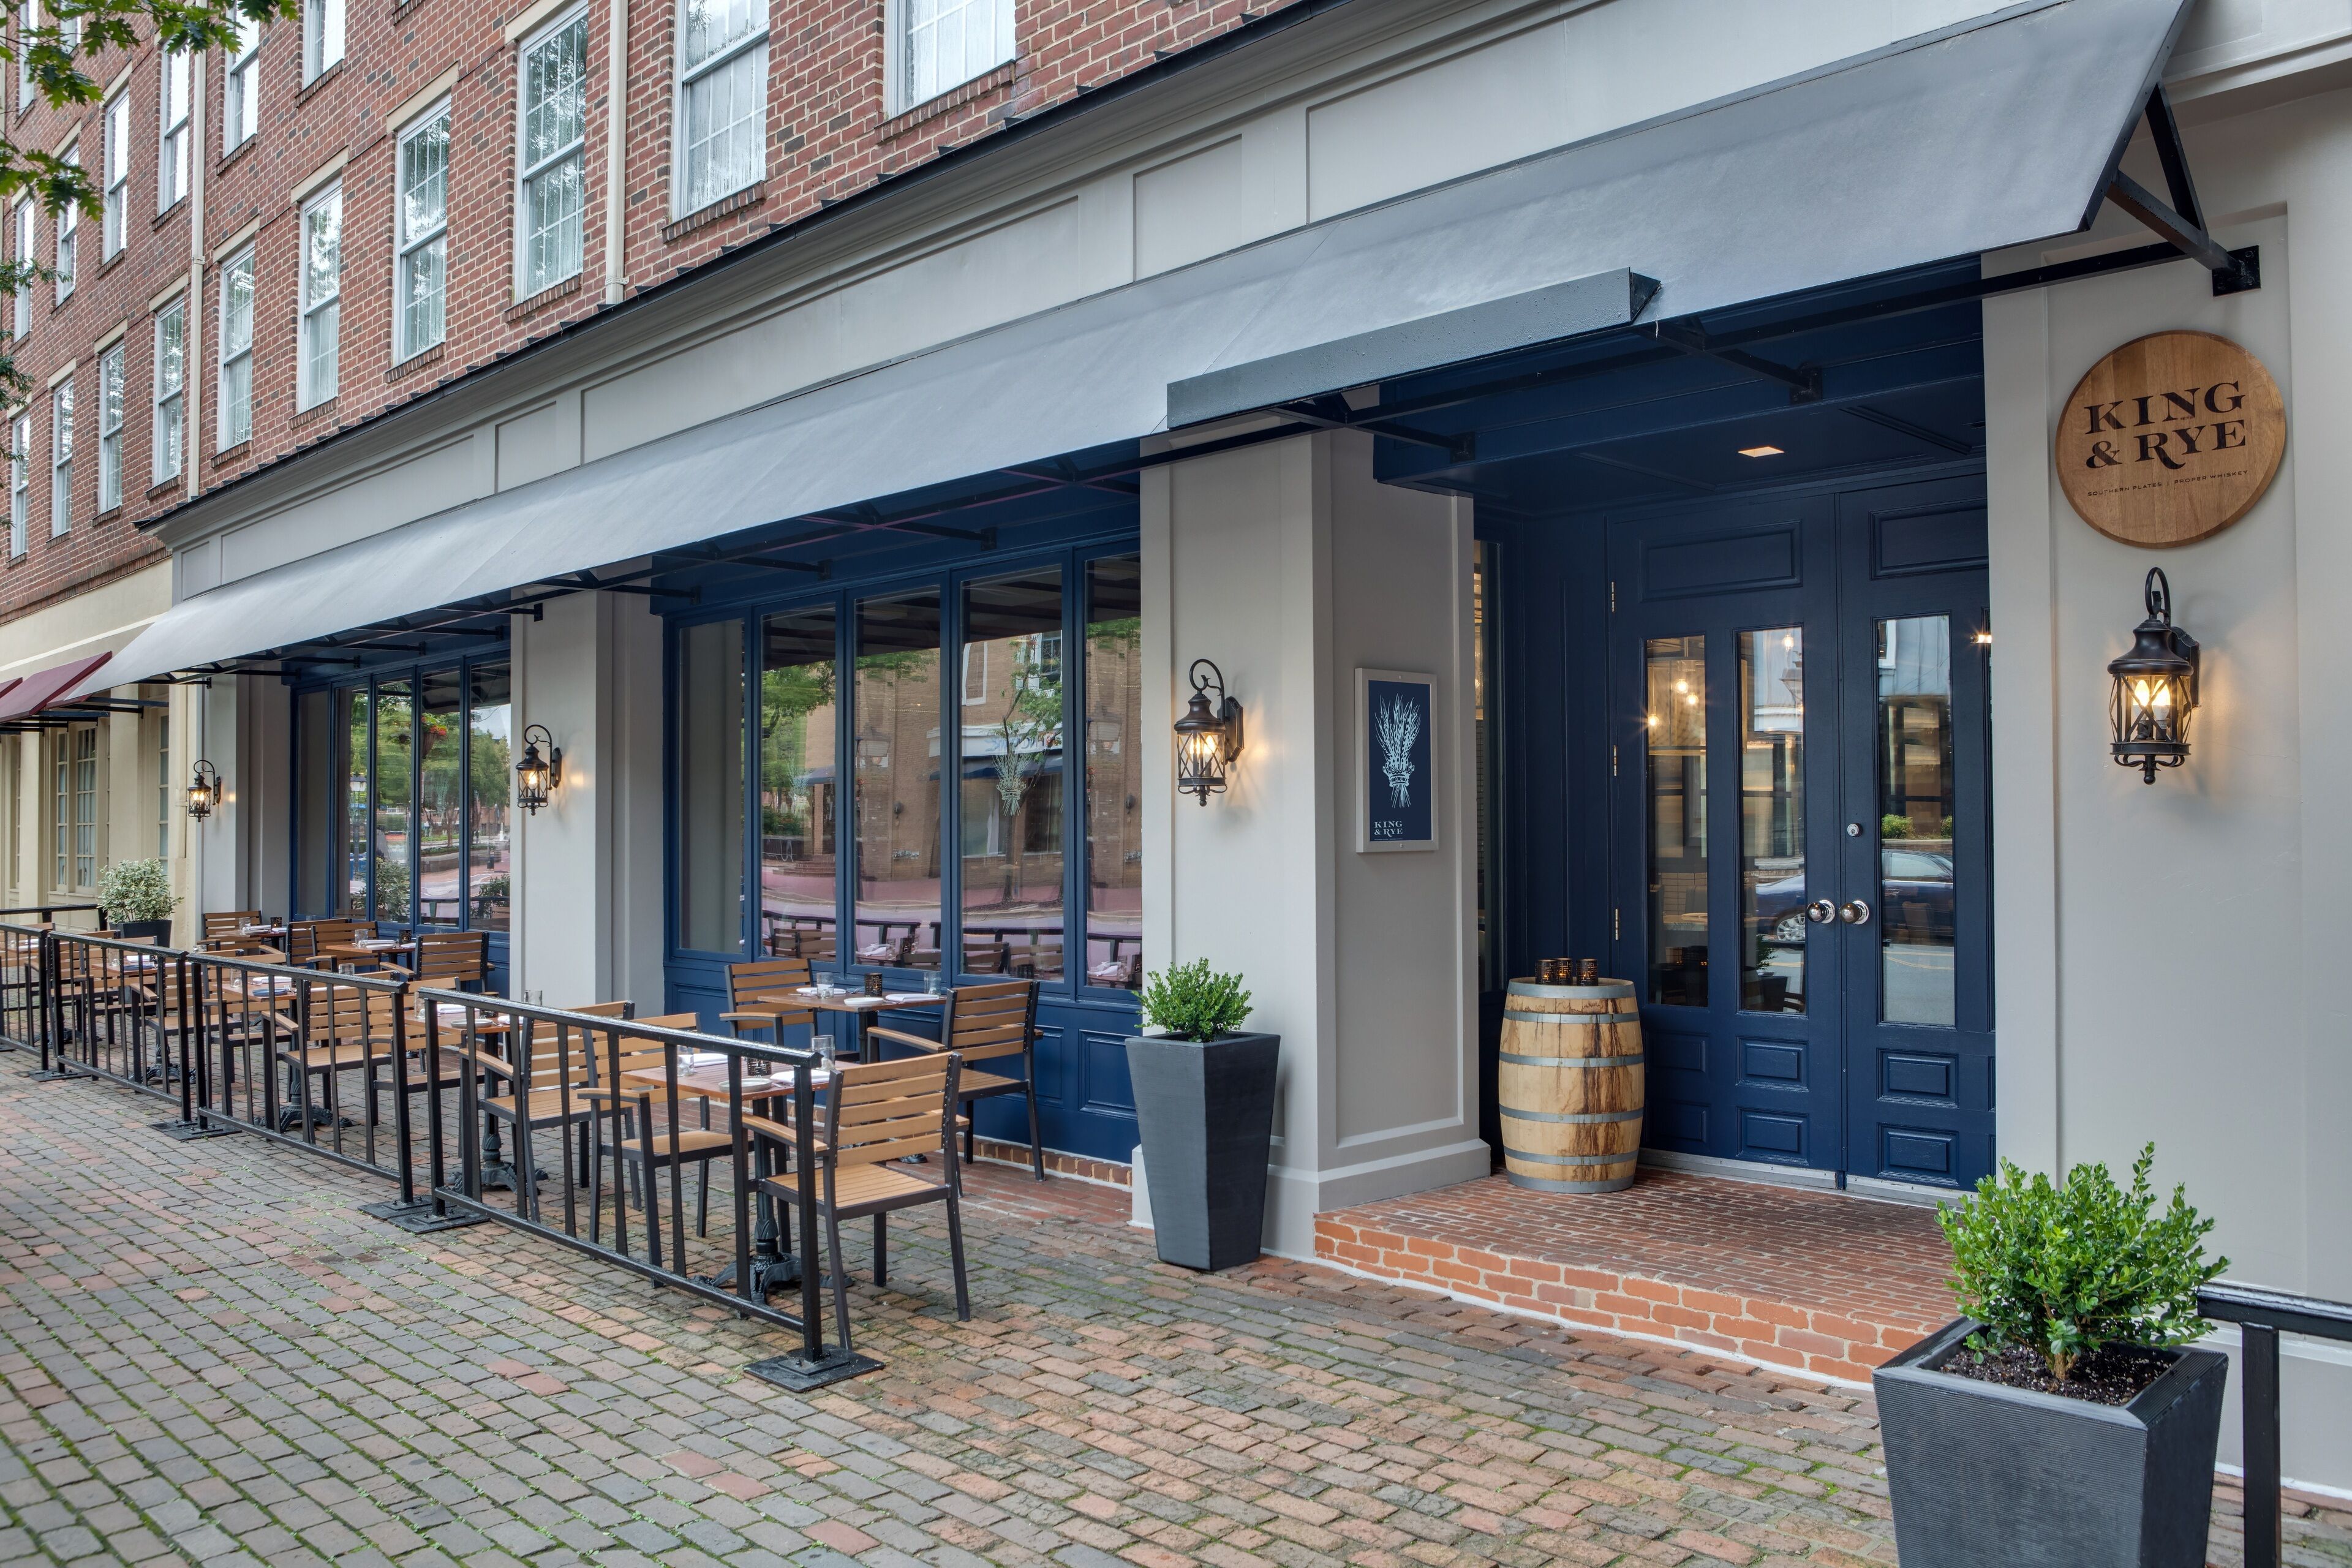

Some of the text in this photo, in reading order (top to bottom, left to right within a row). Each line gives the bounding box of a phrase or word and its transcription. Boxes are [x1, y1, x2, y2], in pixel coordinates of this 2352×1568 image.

[2084, 380, 2246, 435] KING
[2086, 420, 2246, 470] & RYE
[2087, 487, 2130, 497] SOUTHERN
[2174, 476, 2206, 484] PROPER
[2210, 470, 2248, 478] WHISKEY
[1382, 828, 1403, 837] RYE
